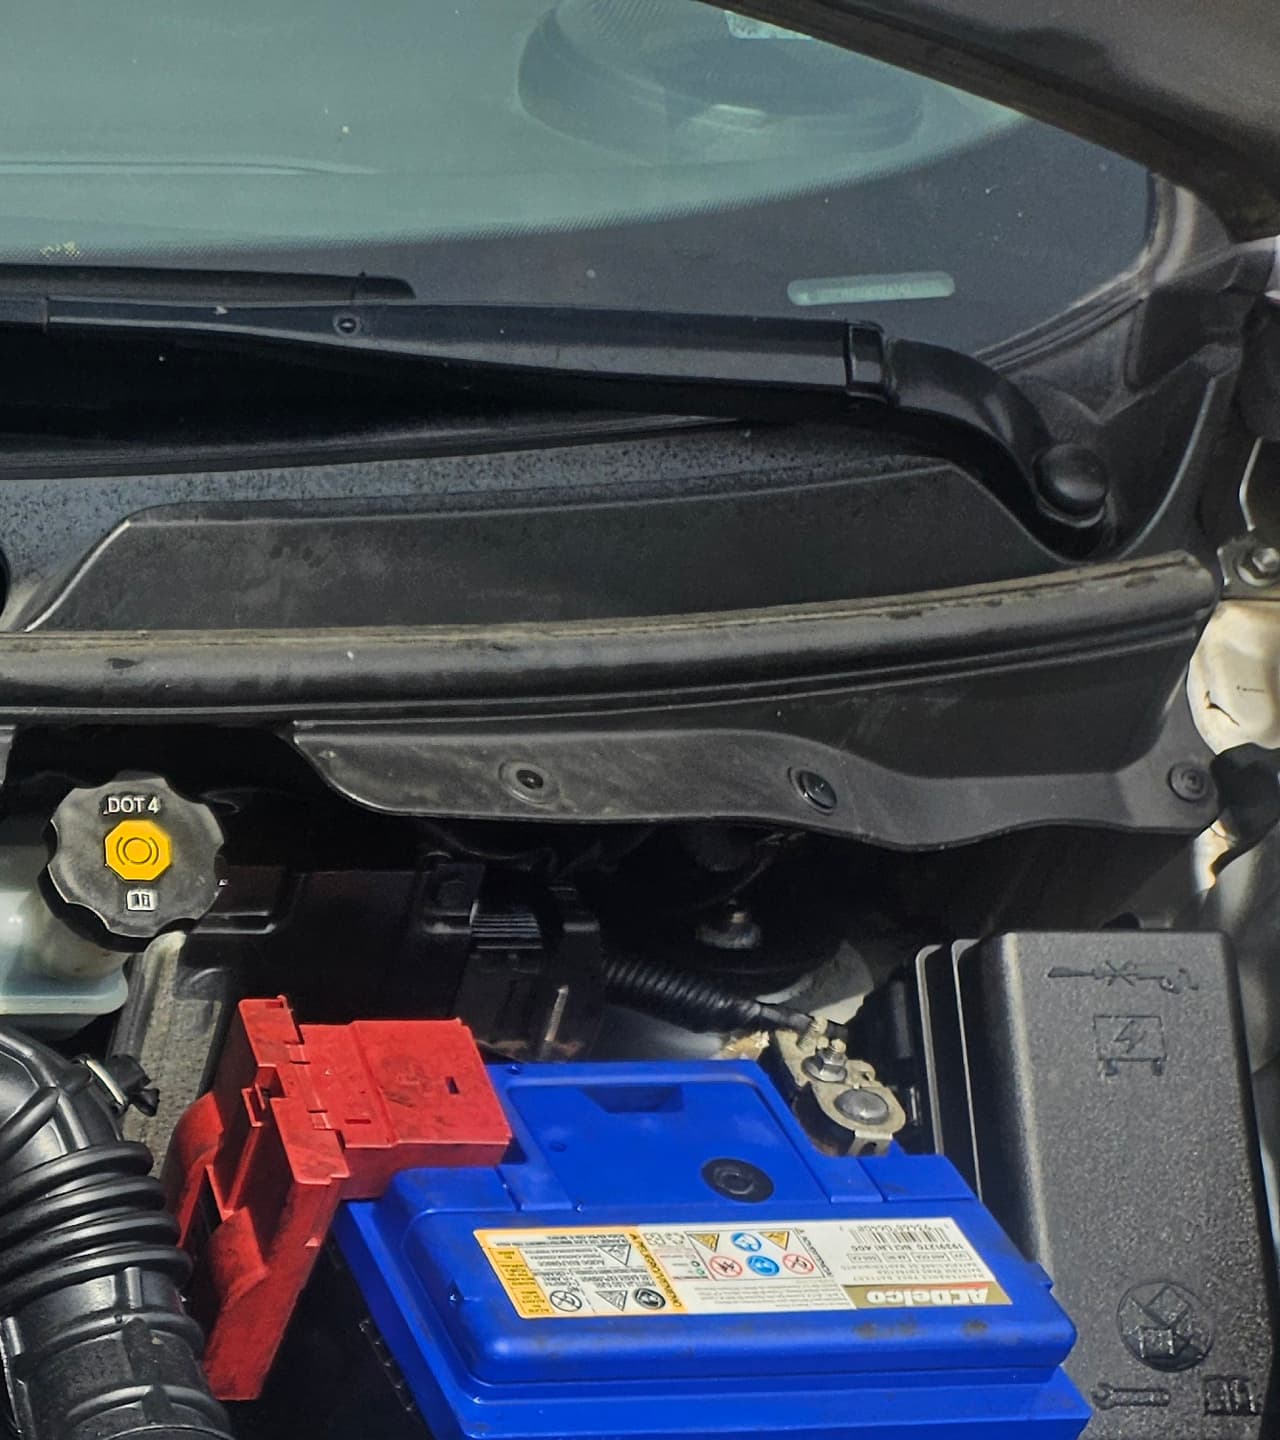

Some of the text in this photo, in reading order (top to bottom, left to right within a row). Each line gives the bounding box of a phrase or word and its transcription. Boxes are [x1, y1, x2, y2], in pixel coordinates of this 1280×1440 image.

[107, 796, 161, 814] DOT 4
[866, 1288, 989, 1306] ACDelco
